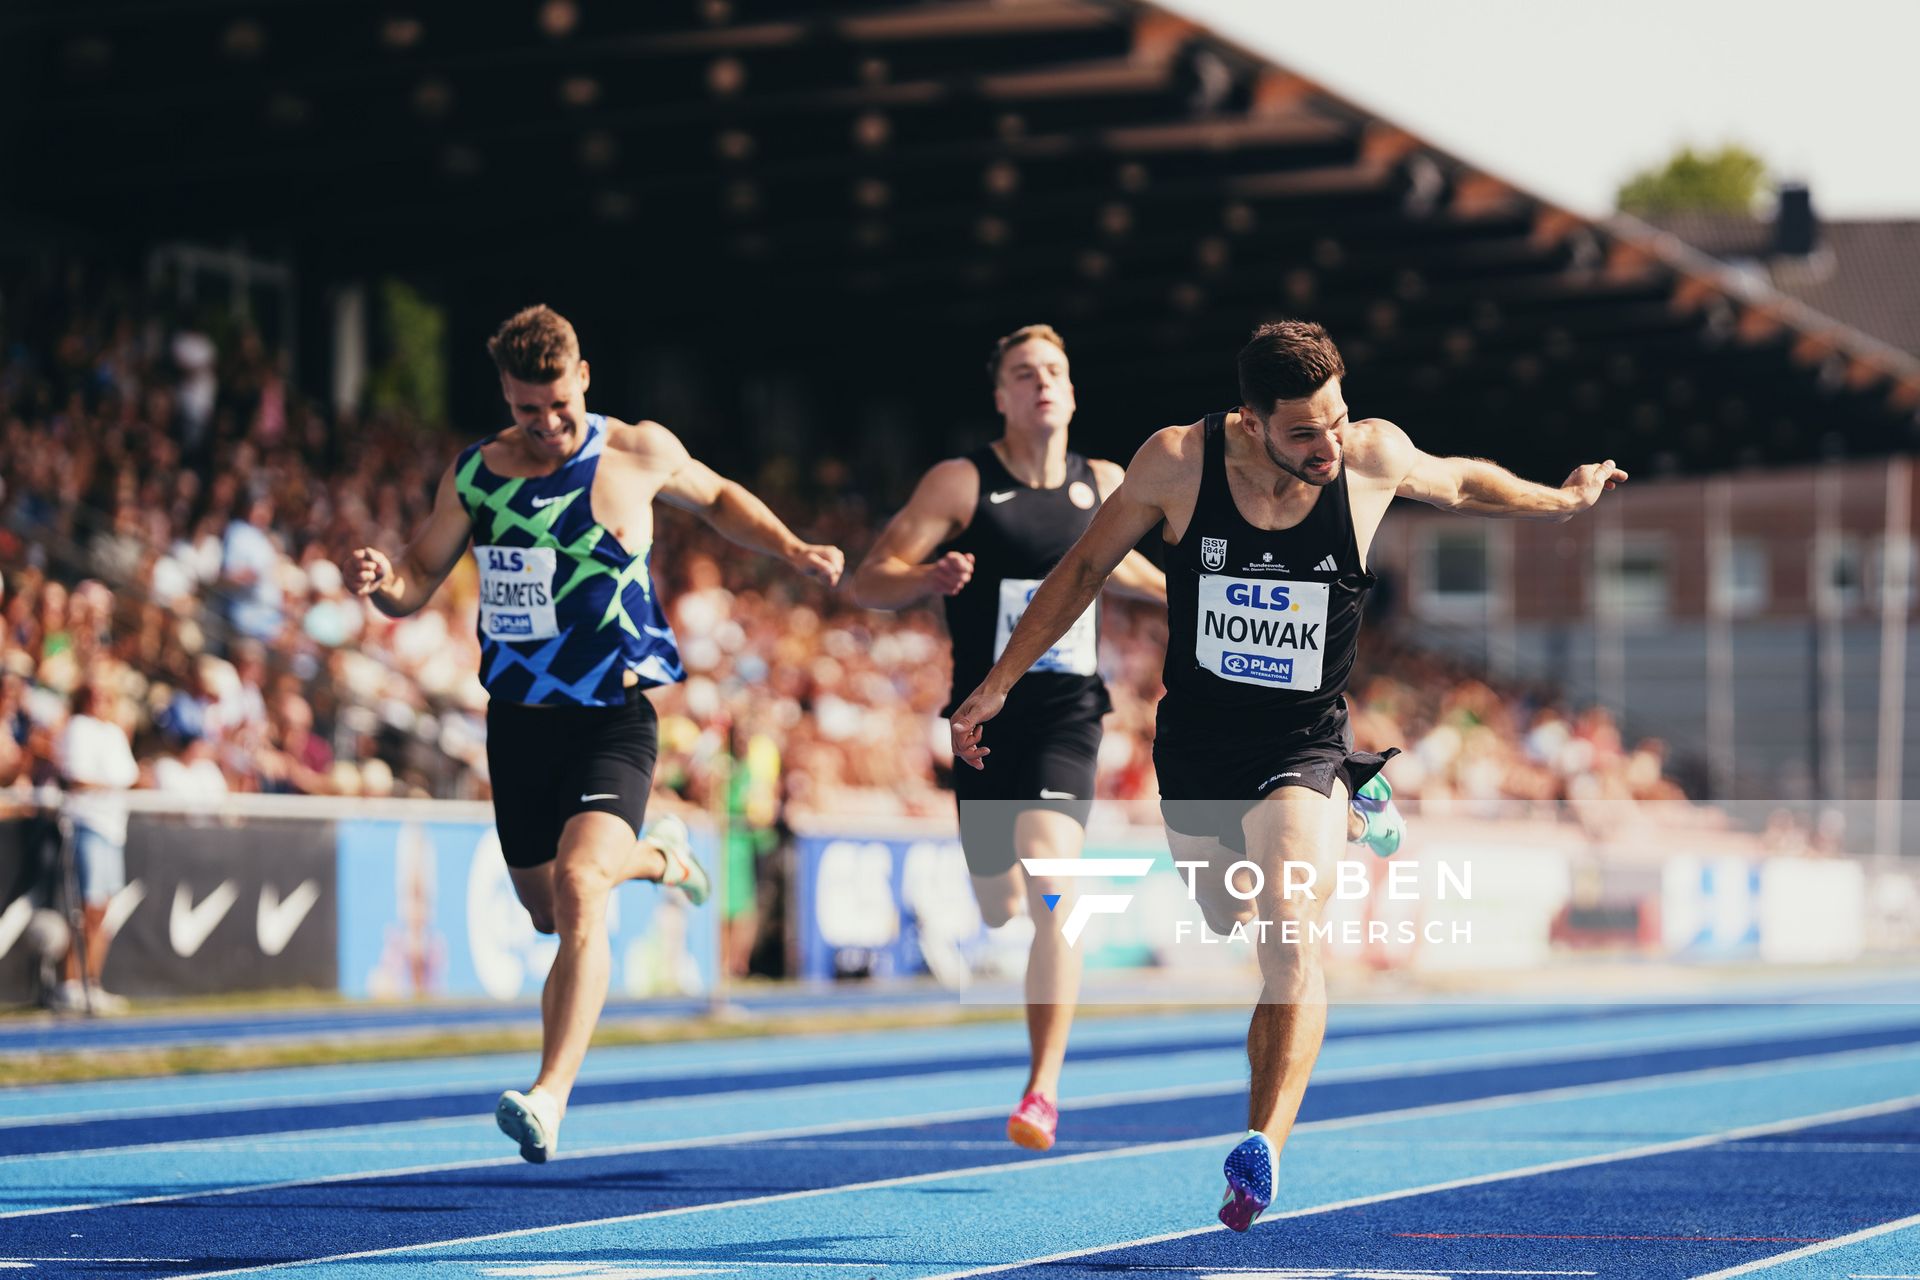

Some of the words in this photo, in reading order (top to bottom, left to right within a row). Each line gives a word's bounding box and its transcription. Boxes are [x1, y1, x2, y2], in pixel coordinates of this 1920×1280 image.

[1203, 538, 1226, 548] SSV
[1203, 546, 1225, 555] 1846
[1204, 609, 1320, 651] NOWAK
[1250, 658, 1290, 675] PLAN
[1250, 671, 1289, 680] INTERNATIONAL
